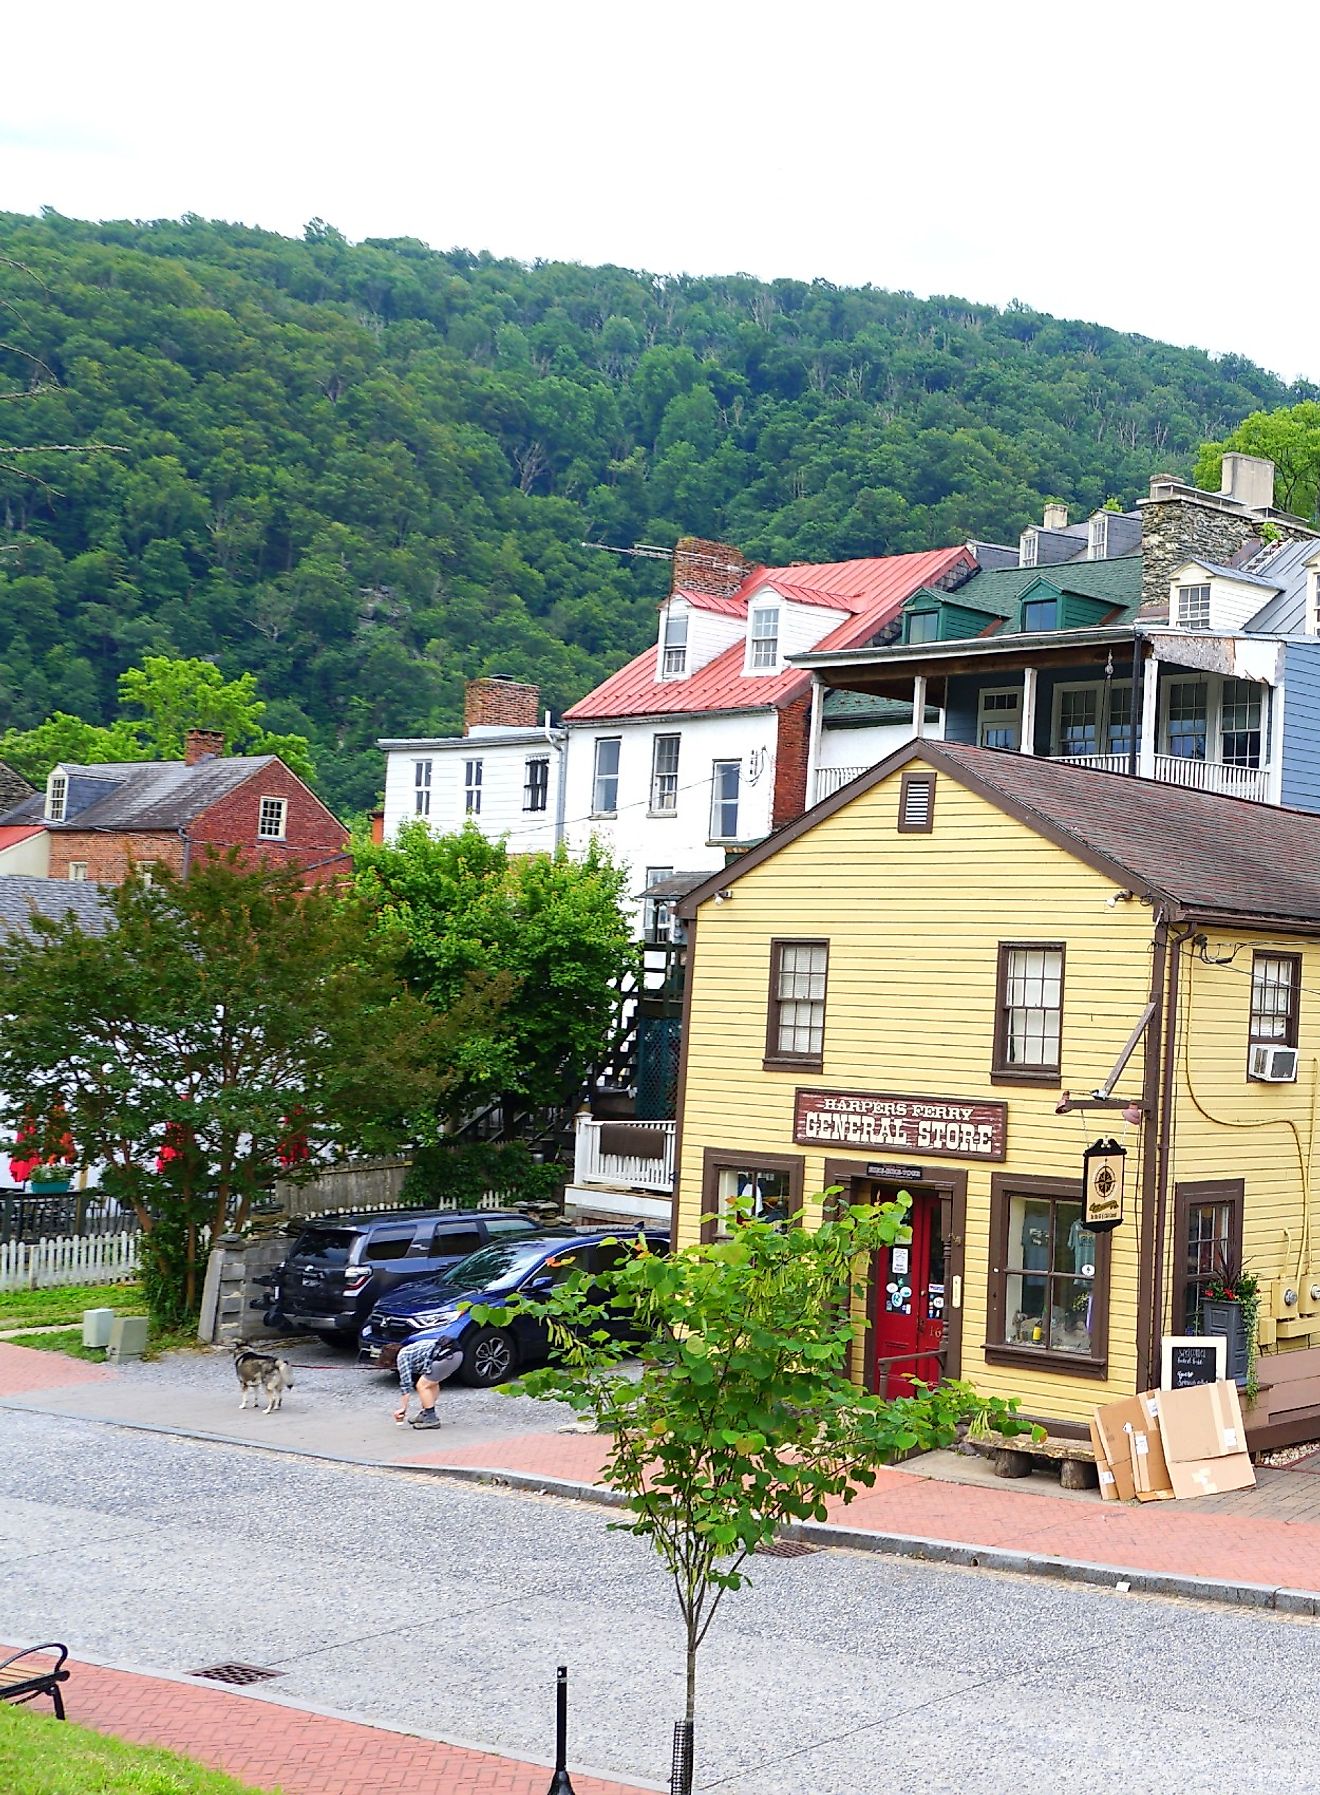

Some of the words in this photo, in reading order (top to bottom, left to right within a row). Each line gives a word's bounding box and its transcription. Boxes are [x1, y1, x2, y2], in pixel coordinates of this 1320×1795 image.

[823, 1098, 908, 1116] HARPERS
[912, 1104, 974, 1121] FERRY
[805, 1111, 907, 1145] GENERAL
[917, 1120, 993, 1153] STORE
